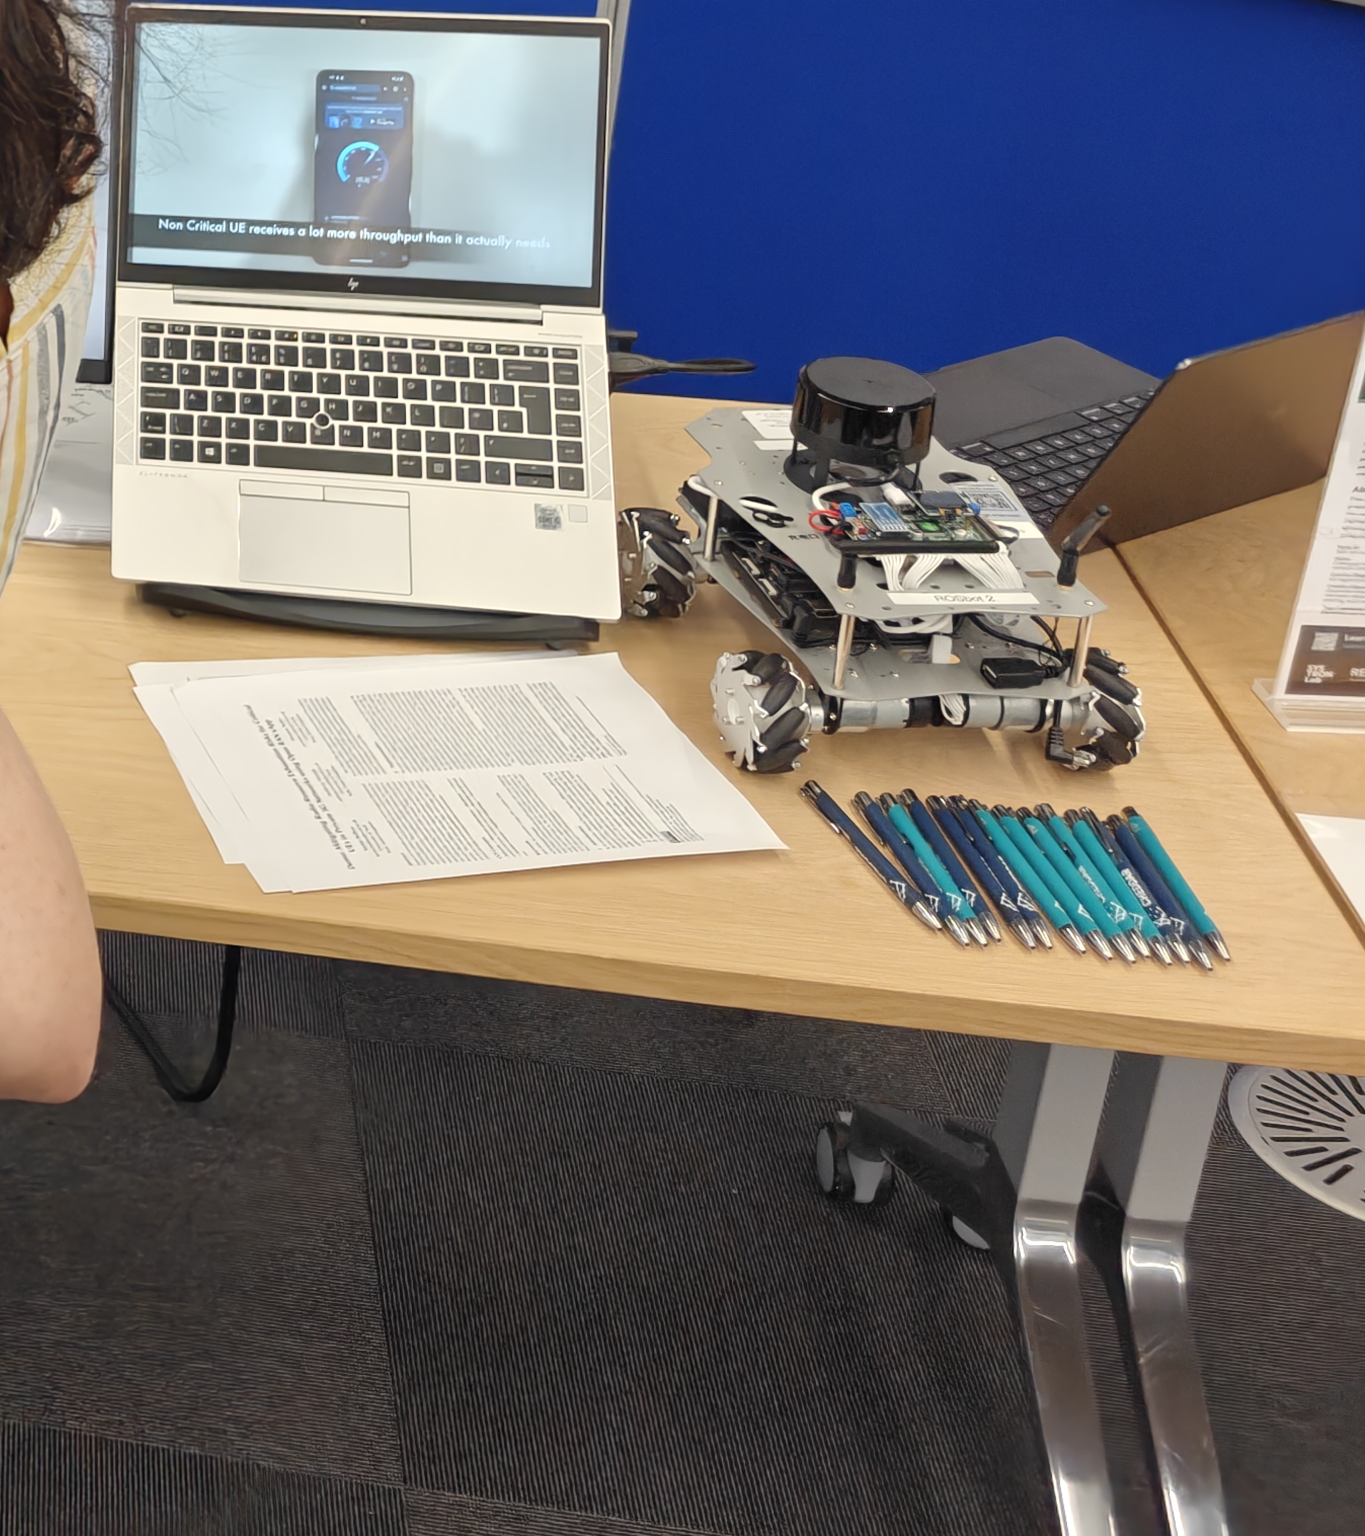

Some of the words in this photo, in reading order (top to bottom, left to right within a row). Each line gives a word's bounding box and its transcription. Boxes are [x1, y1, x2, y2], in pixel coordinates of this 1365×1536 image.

[159, 219, 183, 230] Non
[187, 220, 226, 232] Critical
[230, 222, 246, 233] UE
[249, 224, 295, 236] receives
[298, 228, 306, 236] a
[309, 225, 324, 237] lot
[327, 230, 357, 239] more
[359, 228, 423, 244] throughput
[425, 230, 451, 244] than
[455, 232, 463, 244] it
[466, 234, 512, 250] actually
